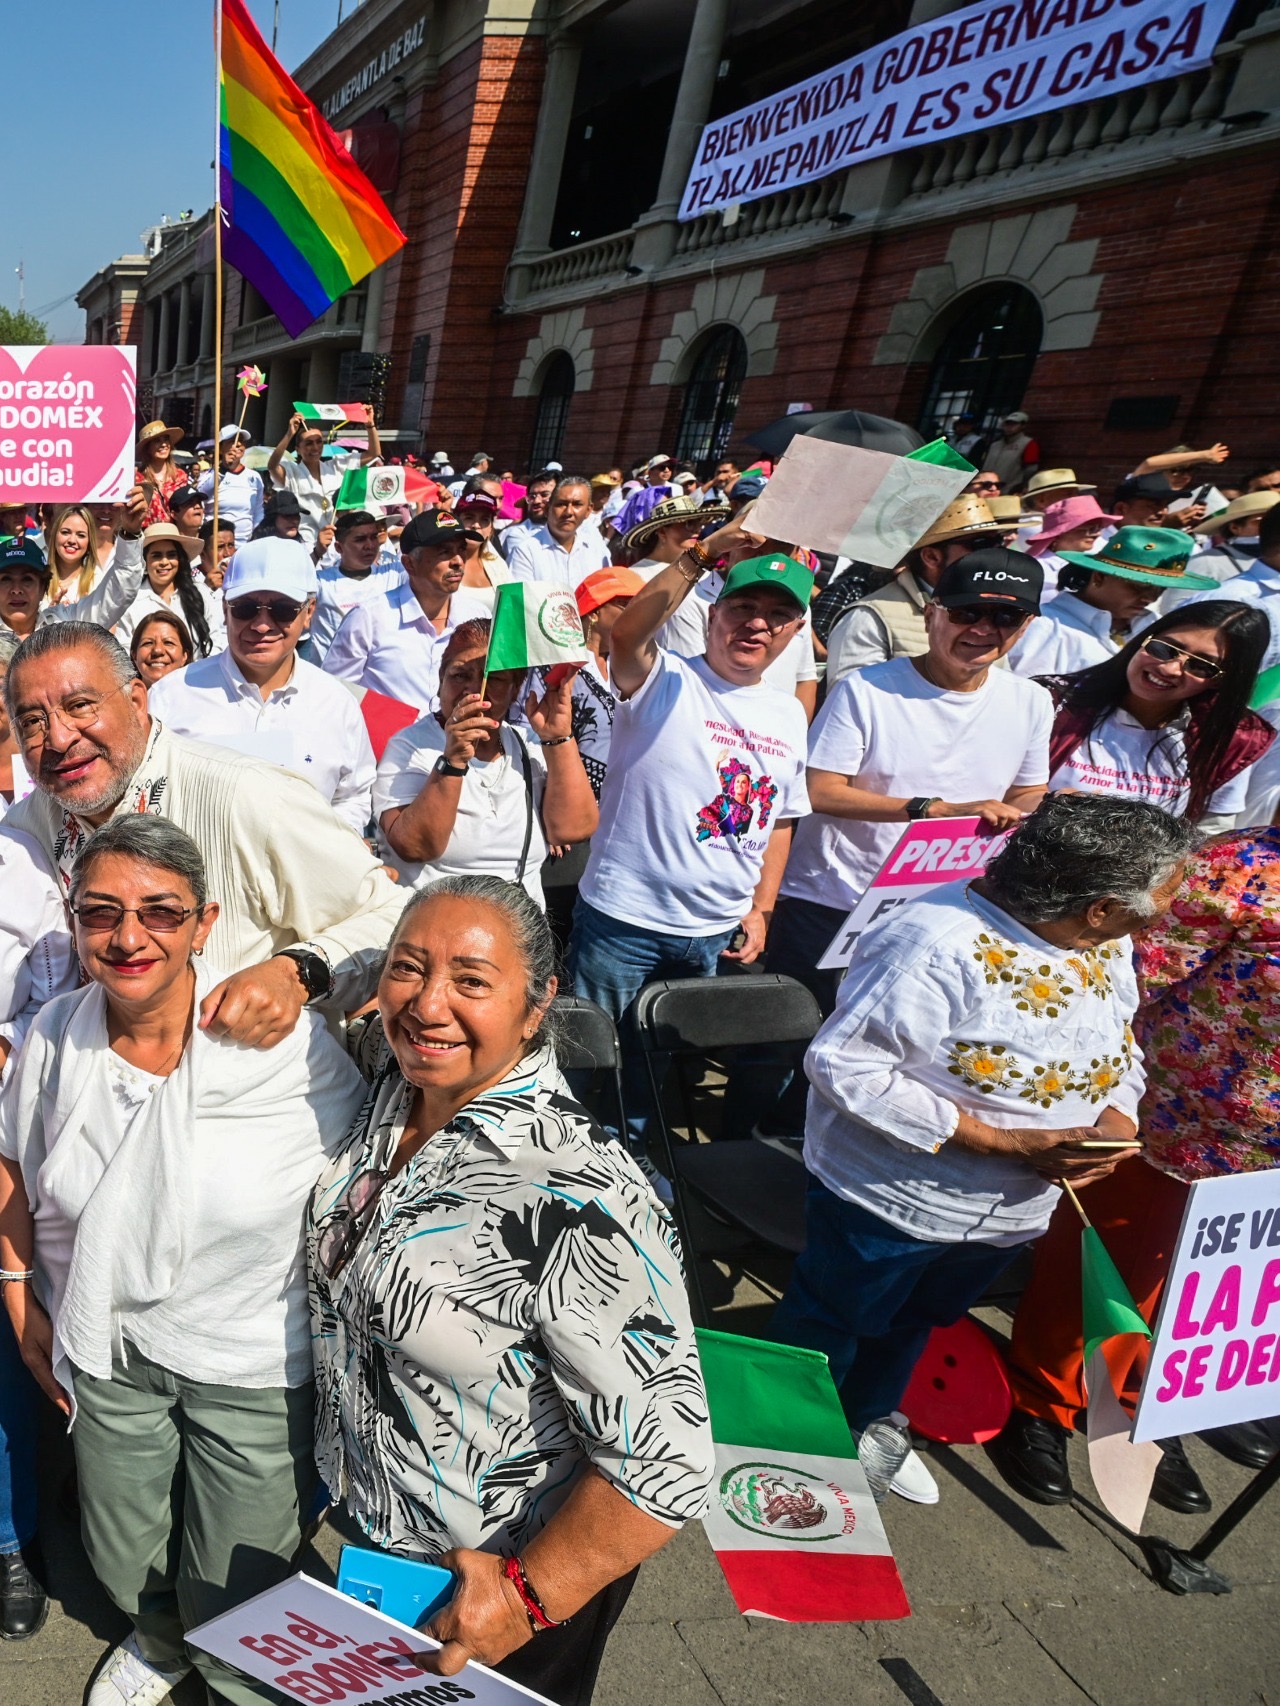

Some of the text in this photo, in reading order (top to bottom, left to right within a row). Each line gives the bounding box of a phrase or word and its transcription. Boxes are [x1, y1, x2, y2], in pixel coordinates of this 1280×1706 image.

[322, 16, 426, 121] TLALNEPANTLA DE BAZ
[700, 0, 1144, 167] BIENVENIDA GOBERNAD
[686, 2, 1207, 213] TLALNEPANTLA ES SU CASA
[22, 438, 73, 458] con
[710, 733, 736, 747] Amor
[1079, 774, 1114, 788] Amor
[1116, 783, 1124, 791] a
[1126, 782, 1138, 793] la
[888, 833, 1008, 875] PRESI
[1190, 1212, 1245, 1260] ¡SE
[1172, 1264, 1242, 1340] LA
[1156, 1344, 1213, 1403] SE
[826, 1481, 857, 1535] VIVA MEXICO
[239, 1633, 312, 1667] En
